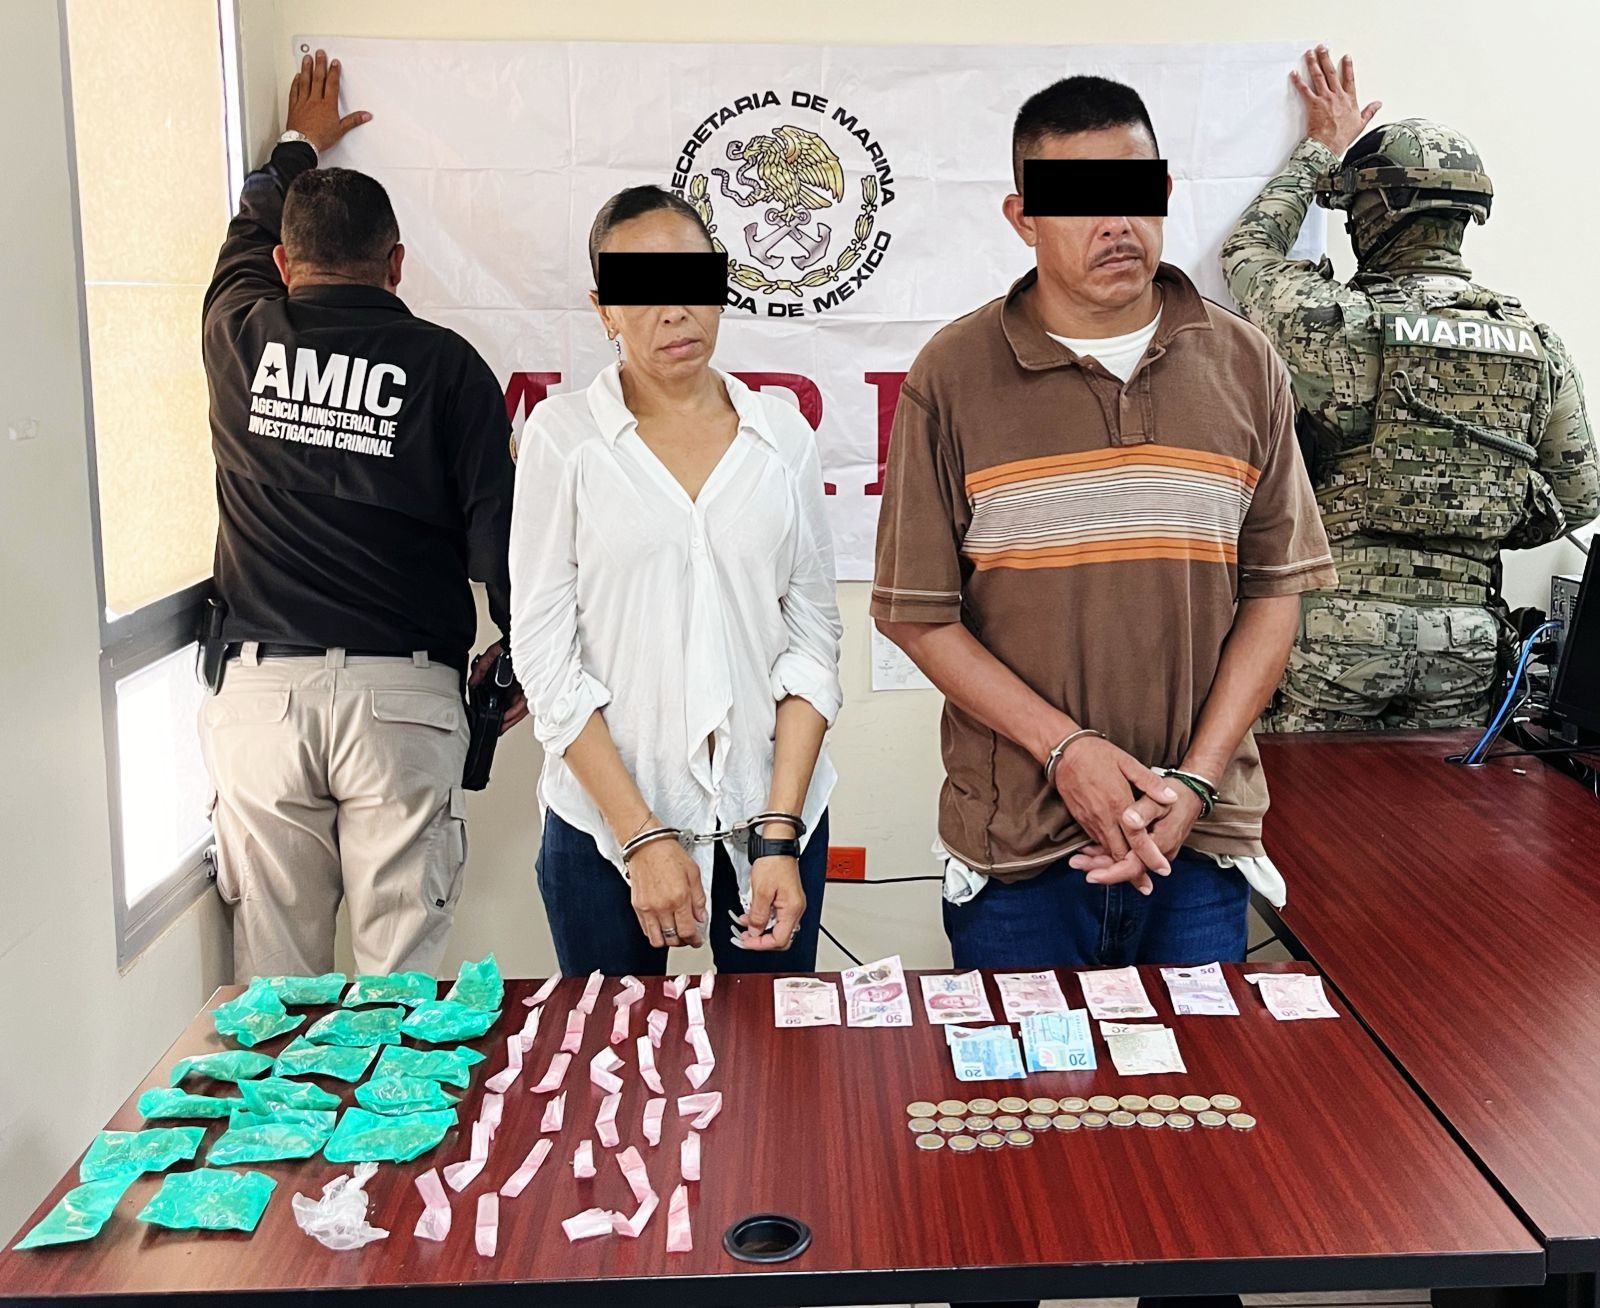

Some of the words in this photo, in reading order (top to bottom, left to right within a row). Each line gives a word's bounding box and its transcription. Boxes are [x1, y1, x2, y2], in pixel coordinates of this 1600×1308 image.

[791, 90, 829, 114] DE
[831, 106, 896, 207] MARINA
[767, 302, 805, 318] DE
[812, 230, 892, 314] MEXICO
[1394, 316, 1539, 356] MARINA
[250, 341, 407, 417] AMIC
[248, 414, 335, 448] INVESTIGACIÓN
[334, 432, 395, 458] CRIMINAL
[250, 395, 300, 421] AGENCIA
[300, 404, 377, 435] MINISTERIAL
[378, 419, 398, 438] DE
[1200, 967, 1216, 975] 50
[885, 1014, 903, 1024] 50
[964, 1068, 983, 1078] 20
[1068, 1052, 1087, 1067] 20
